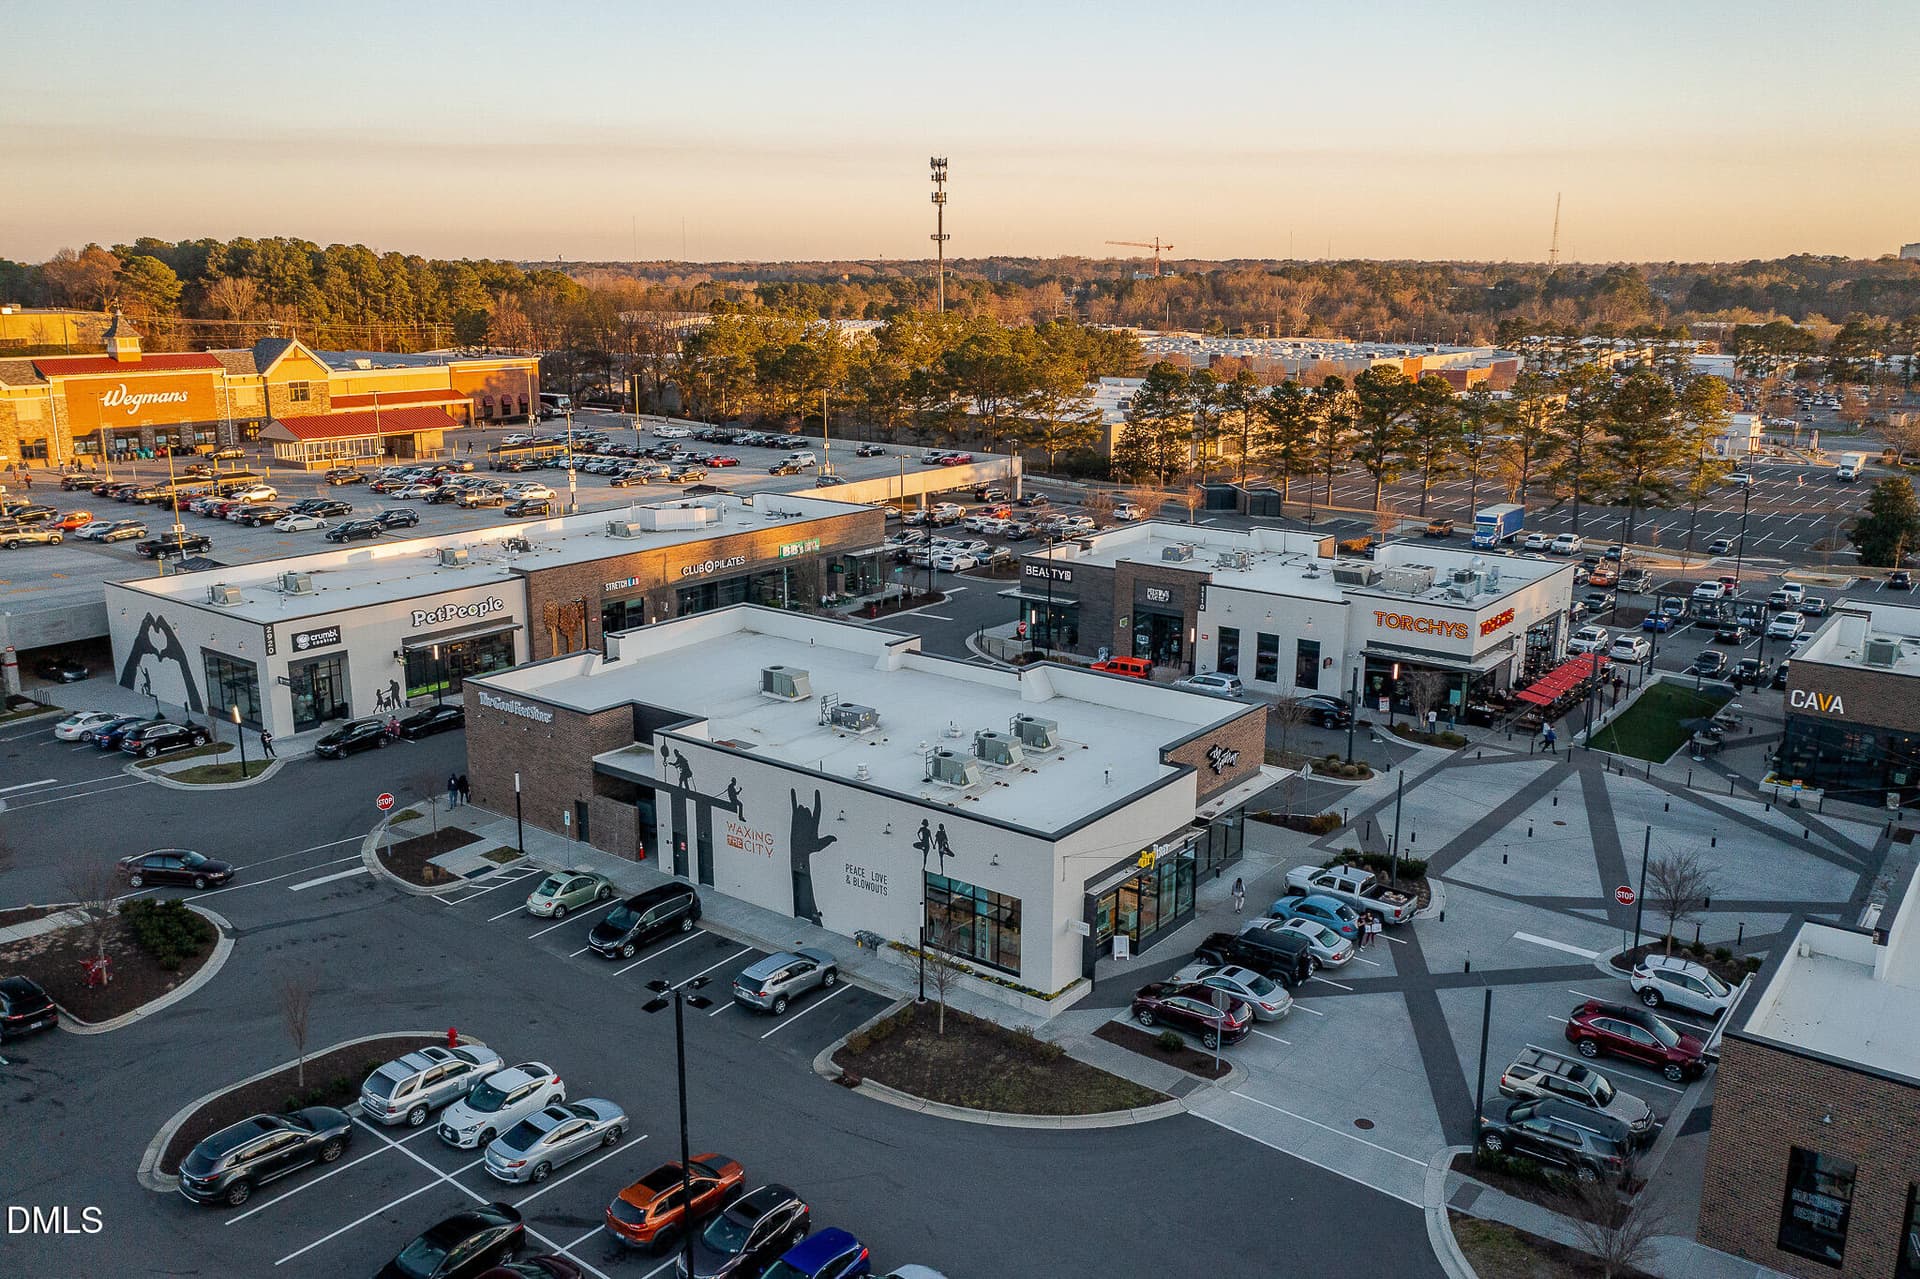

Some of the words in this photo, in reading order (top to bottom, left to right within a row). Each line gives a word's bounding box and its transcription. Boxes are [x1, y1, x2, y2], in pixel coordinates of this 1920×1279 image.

[99, 383, 188, 415] Wegmans
[682, 563, 705, 576] CLUB
[714, 555, 746, 570] PILATES
[604, 579, 628, 592] STRETCH
[411, 596, 504, 627] PetPeople
[310, 628, 338, 641] crumbl
[1373, 610, 1469, 640] TORCHYS
[266, 626, 274, 654] 2920
[1790, 689, 1844, 715] CAVA
[726, 821, 774, 846] WAXING
[744, 840, 775, 858] CITY
[845, 863, 865, 878] PEACE
[871, 871, 888, 885] LOVE
[845, 874, 851, 884] &
[853, 876, 888, 897] BLOWOUTS
[1617, 890, 1634, 900] STOP
